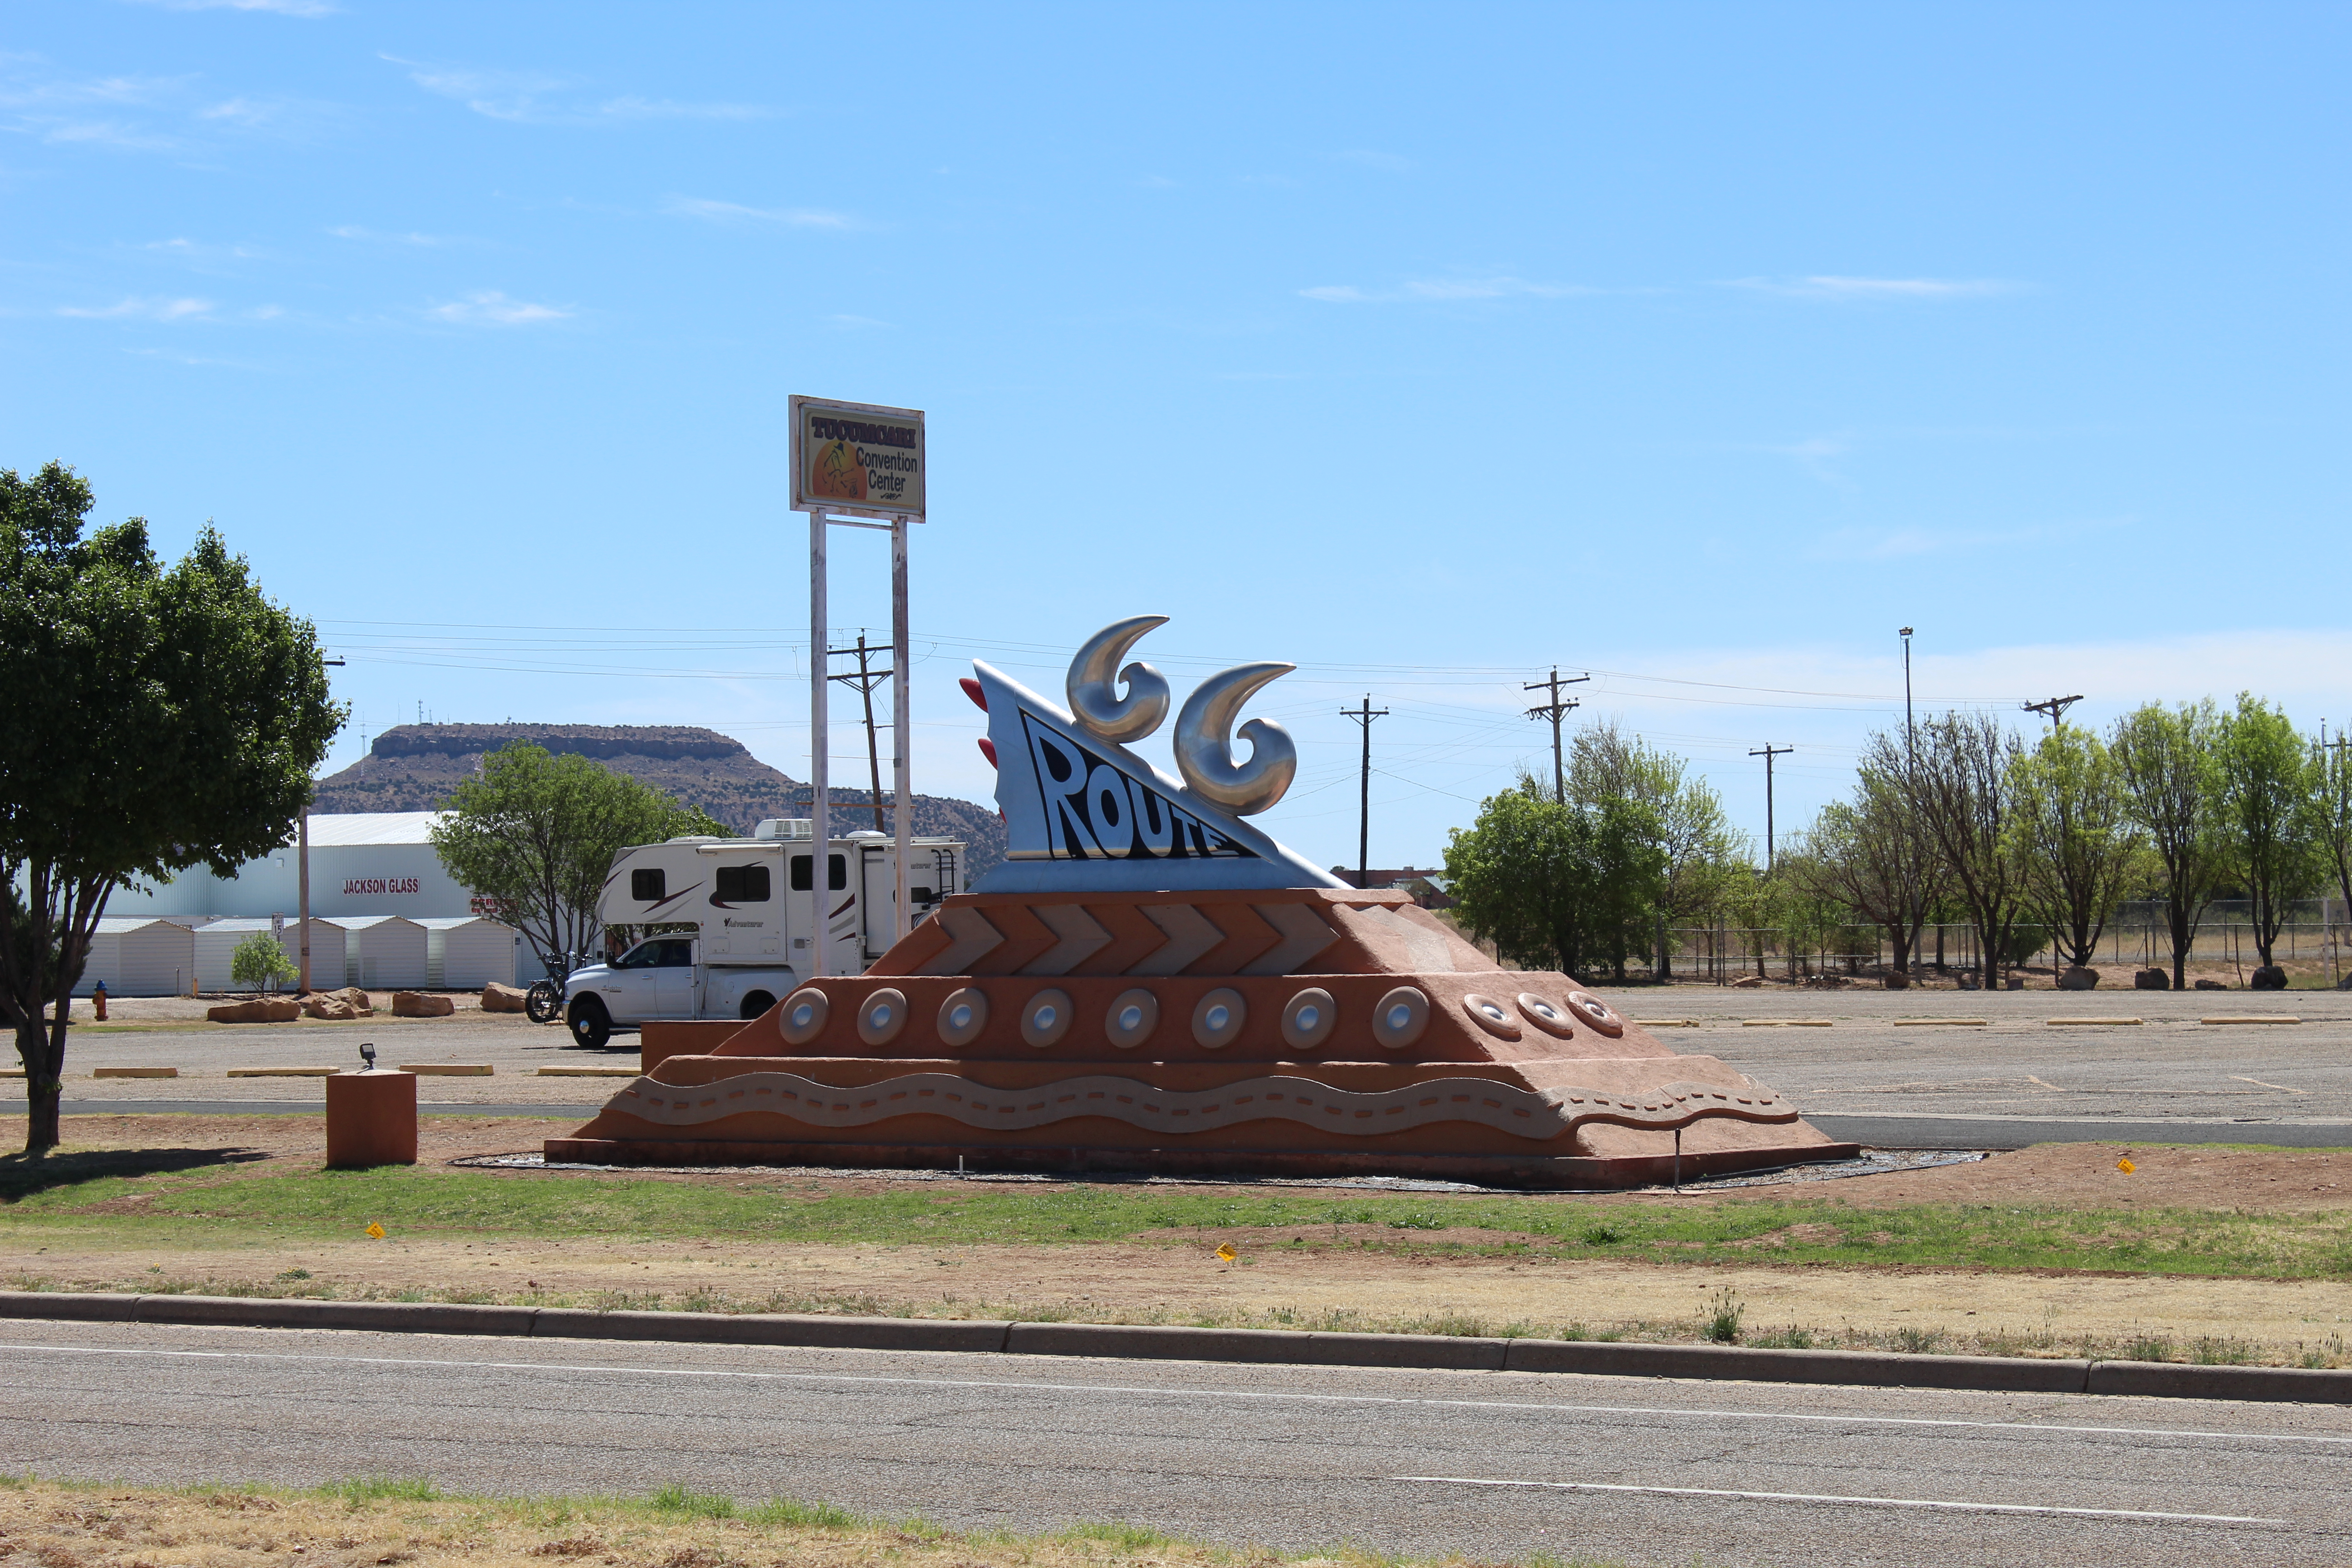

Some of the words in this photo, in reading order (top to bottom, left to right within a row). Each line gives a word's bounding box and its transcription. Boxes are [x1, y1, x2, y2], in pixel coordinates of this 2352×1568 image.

[812, 416, 916, 449] TUCUMCARI
[856, 446, 917, 473] Convention
[868, 469, 906, 492] Center
[1024, 714, 1240, 859] ROUTE
[343, 879, 386, 895] JACKSON
[389, 878, 419, 893] GLASS
[274, 925, 282, 934] 15
